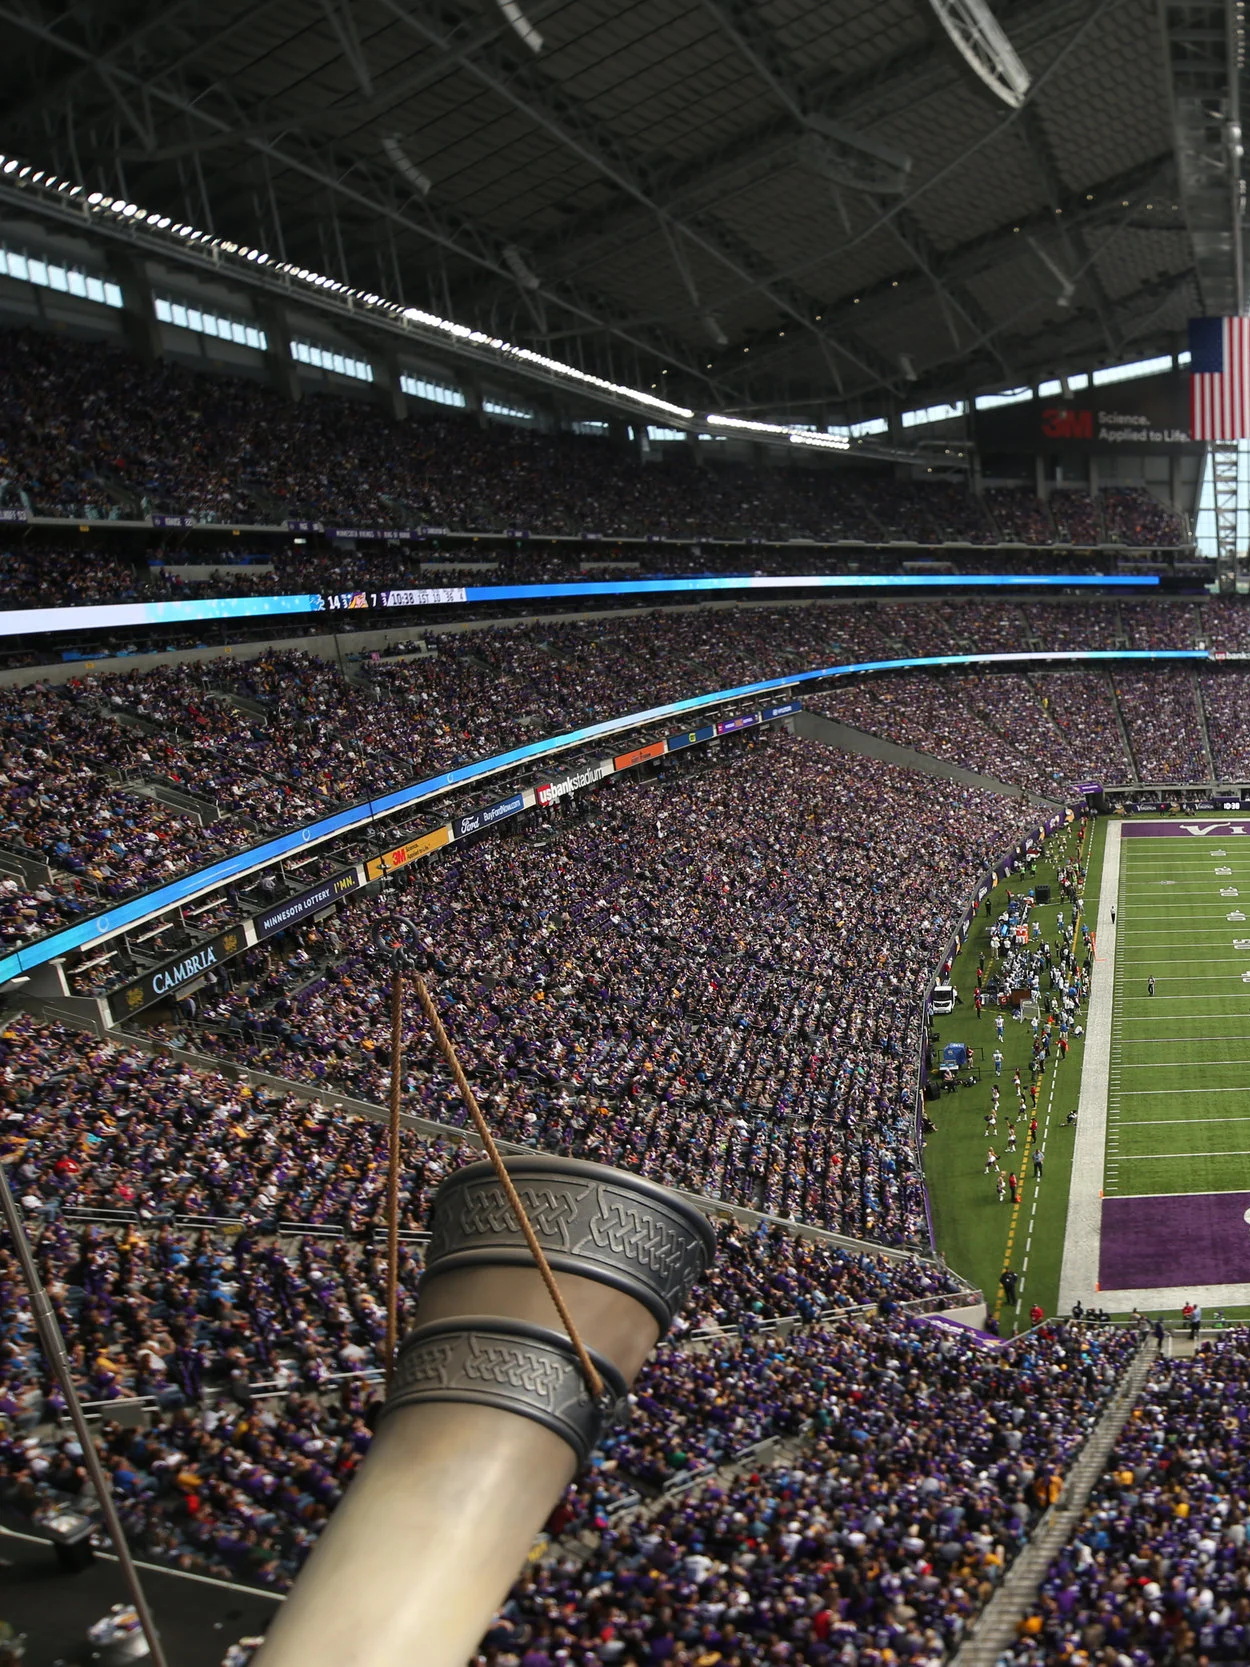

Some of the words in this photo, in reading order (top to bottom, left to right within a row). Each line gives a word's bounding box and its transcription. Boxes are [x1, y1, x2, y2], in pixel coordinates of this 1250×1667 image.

[1042, 409, 1093, 438] 3M
[1098, 411, 1150, 425] Science.
[1098, 428, 1147, 443] Applied
[1150, 429, 1162, 442] to
[1163, 429, 1190, 442] Life.
[328, 595, 341, 609] 14
[391, 592, 414, 605] 10:38
[461, 815, 480, 834] Ford
[392, 848, 406, 866] 3M
[263, 903, 303, 930] MINNESOTA
[303, 888, 330, 909] LOTTERY
[152, 949, 217, 994] CAMBRIA
